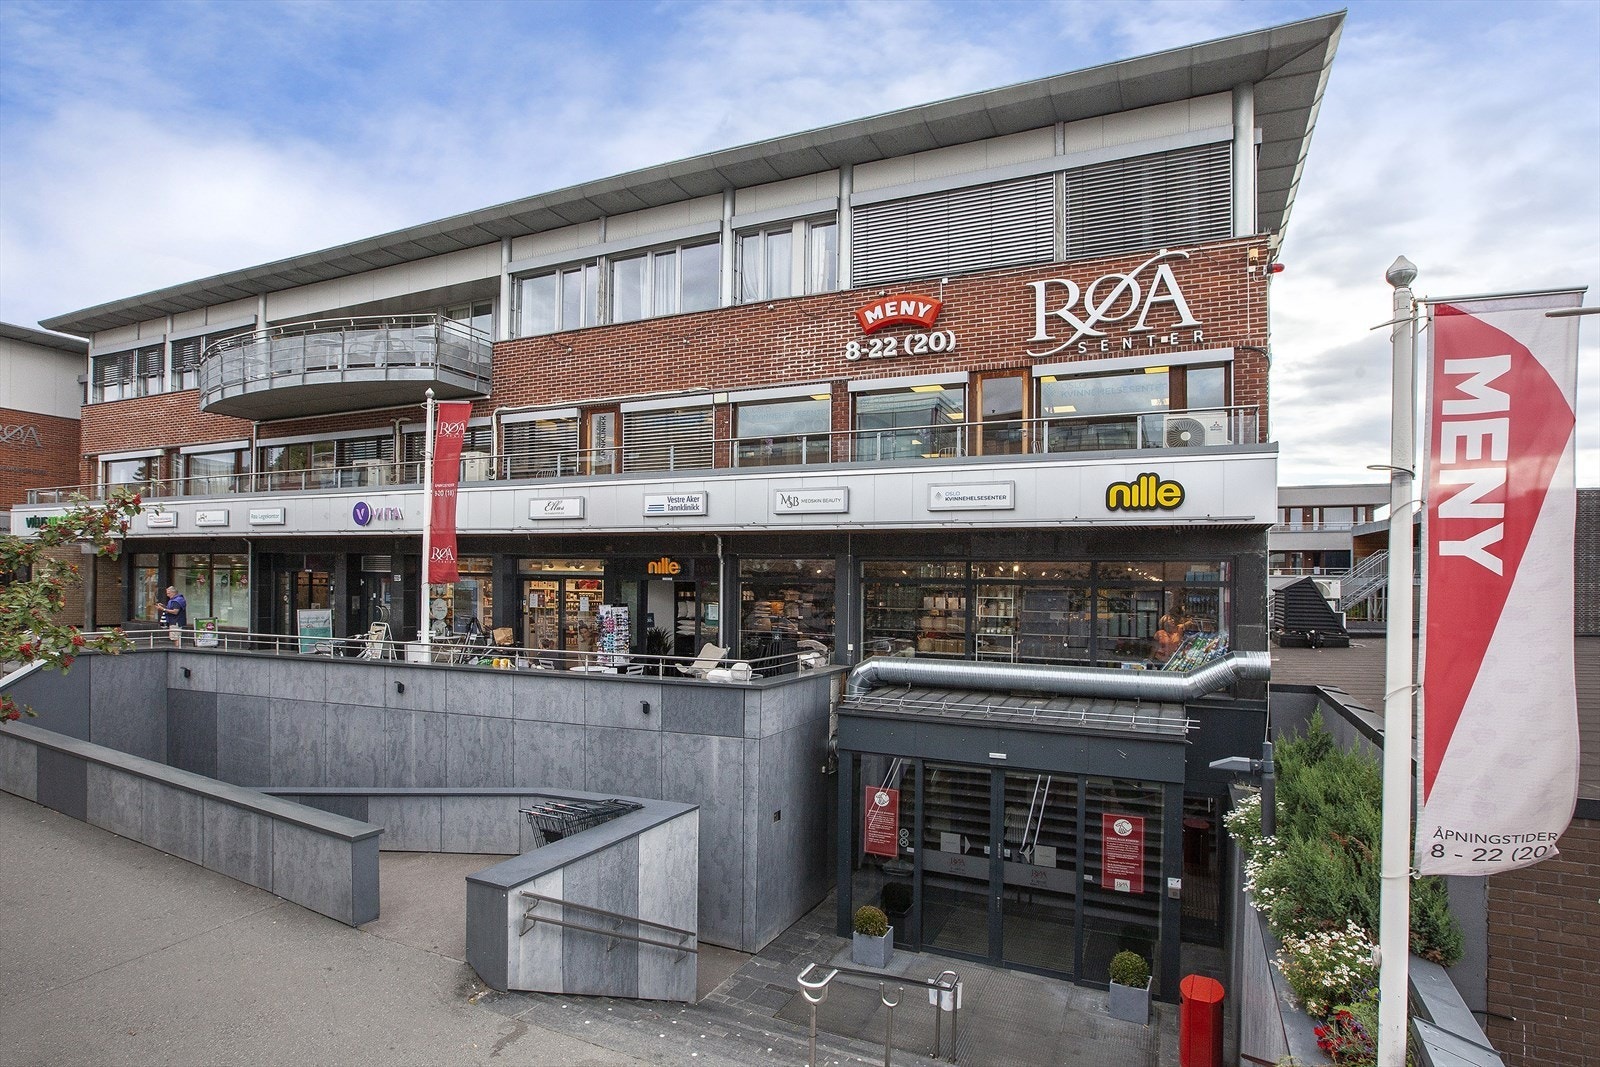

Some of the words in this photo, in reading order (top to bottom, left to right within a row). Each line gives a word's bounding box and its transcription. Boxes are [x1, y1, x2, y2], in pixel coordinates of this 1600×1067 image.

[864, 300, 932, 325] MENY
[1026, 250, 1203, 357] RØA
[845, 336, 898, 361] 8-22
[904, 330, 956, 356] (20)
[1078, 330, 1204, 354] SENTER
[1438, 354, 1511, 576] MENY
[686, 495, 700, 503] Aker
[1107, 474, 1184, 510] nille
[372, 507, 403, 520] VITA
[667, 503, 700, 511] Tannklinikk
[647, 557, 681, 575] nille
[1433, 826, 1557, 845] ÅPNINGSTIDER
[1430, 844, 1445, 858] 8
[1471, 848, 1503, 862] 22
